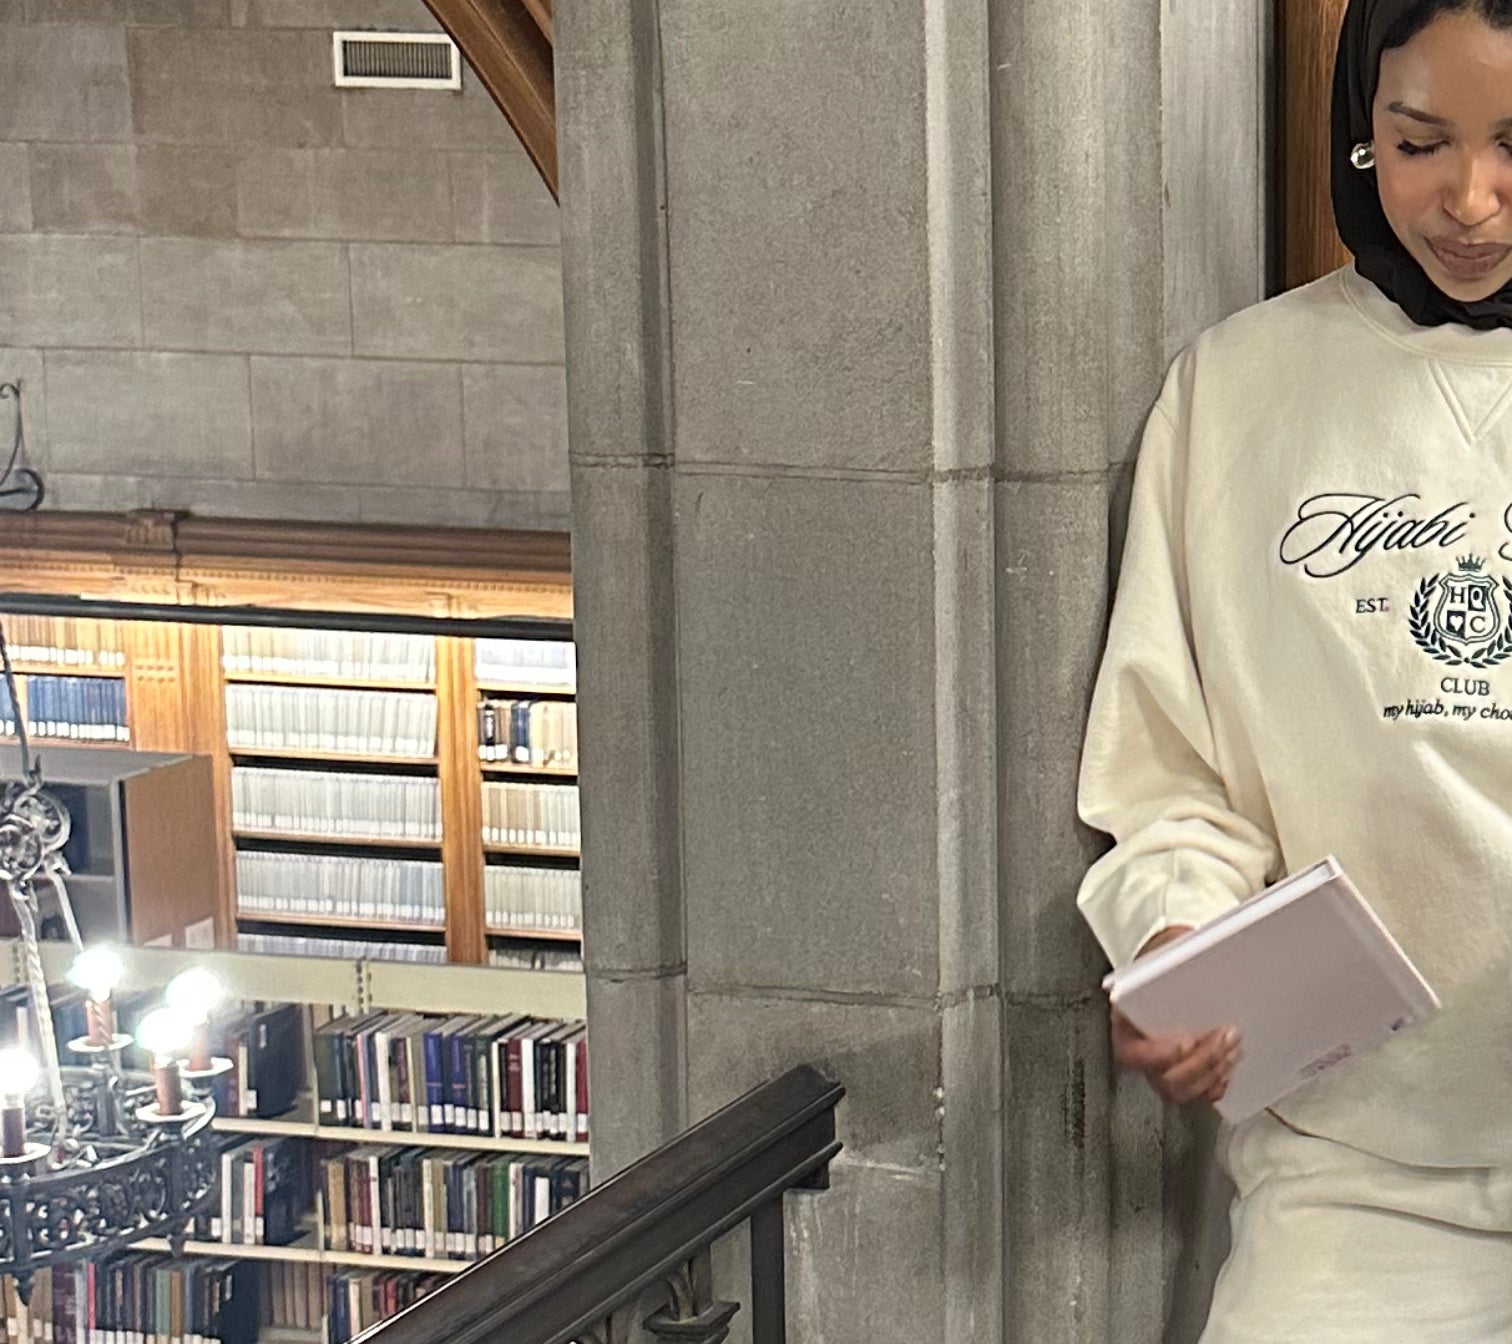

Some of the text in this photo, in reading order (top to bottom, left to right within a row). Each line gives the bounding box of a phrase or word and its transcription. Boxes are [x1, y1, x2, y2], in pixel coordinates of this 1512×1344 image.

[1279, 492, 1476, 578] Hijabi
[1355, 597, 1390, 614] EST.
[1440, 676, 1490, 696] CLUB
[1383, 705, 1404, 721] my
[1404, 698, 1449, 719] hijab,
[1452, 705, 1476, 721] my
